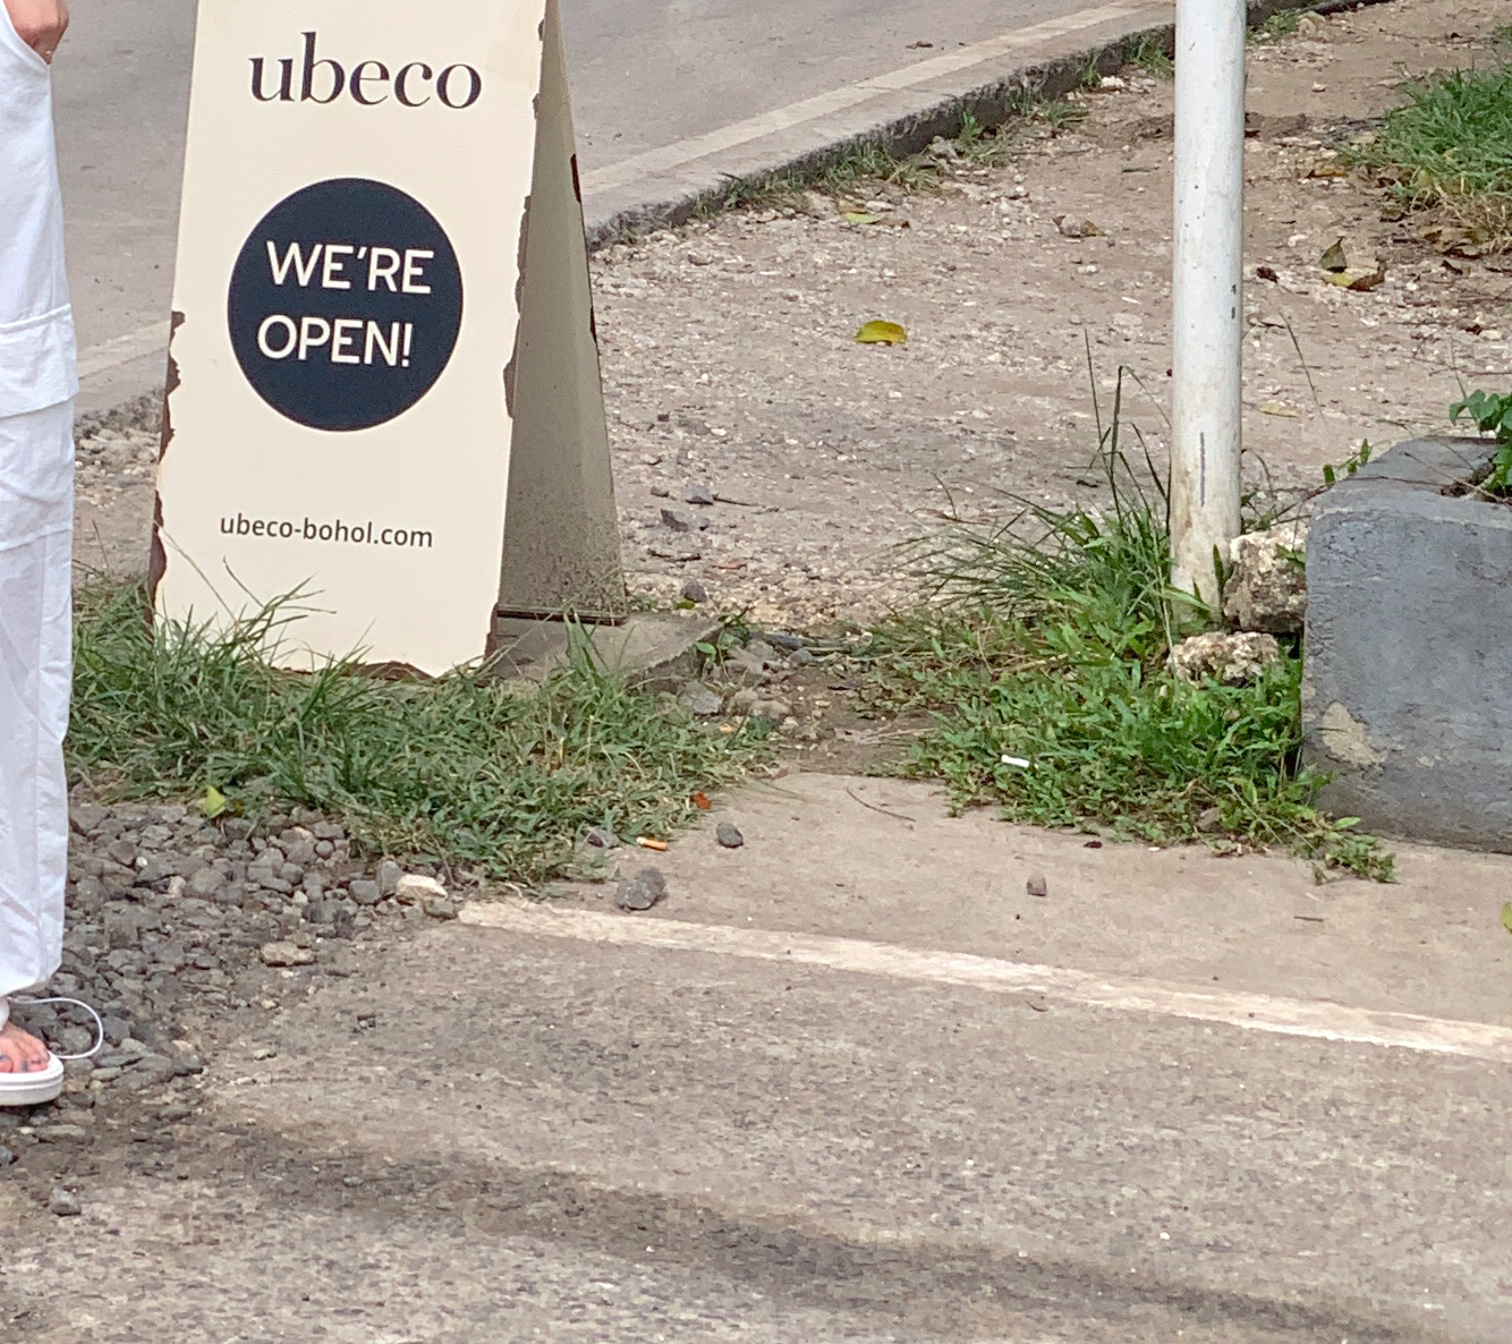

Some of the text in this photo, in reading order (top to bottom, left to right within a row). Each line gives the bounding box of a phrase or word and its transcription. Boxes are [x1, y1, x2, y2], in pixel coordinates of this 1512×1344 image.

[249, 32, 482, 108] ubeco
[267, 241, 435, 294] WE'RE
[257, 315, 413, 368] OPEN!
[220, 512, 433, 548] ubeco-bohol.com
